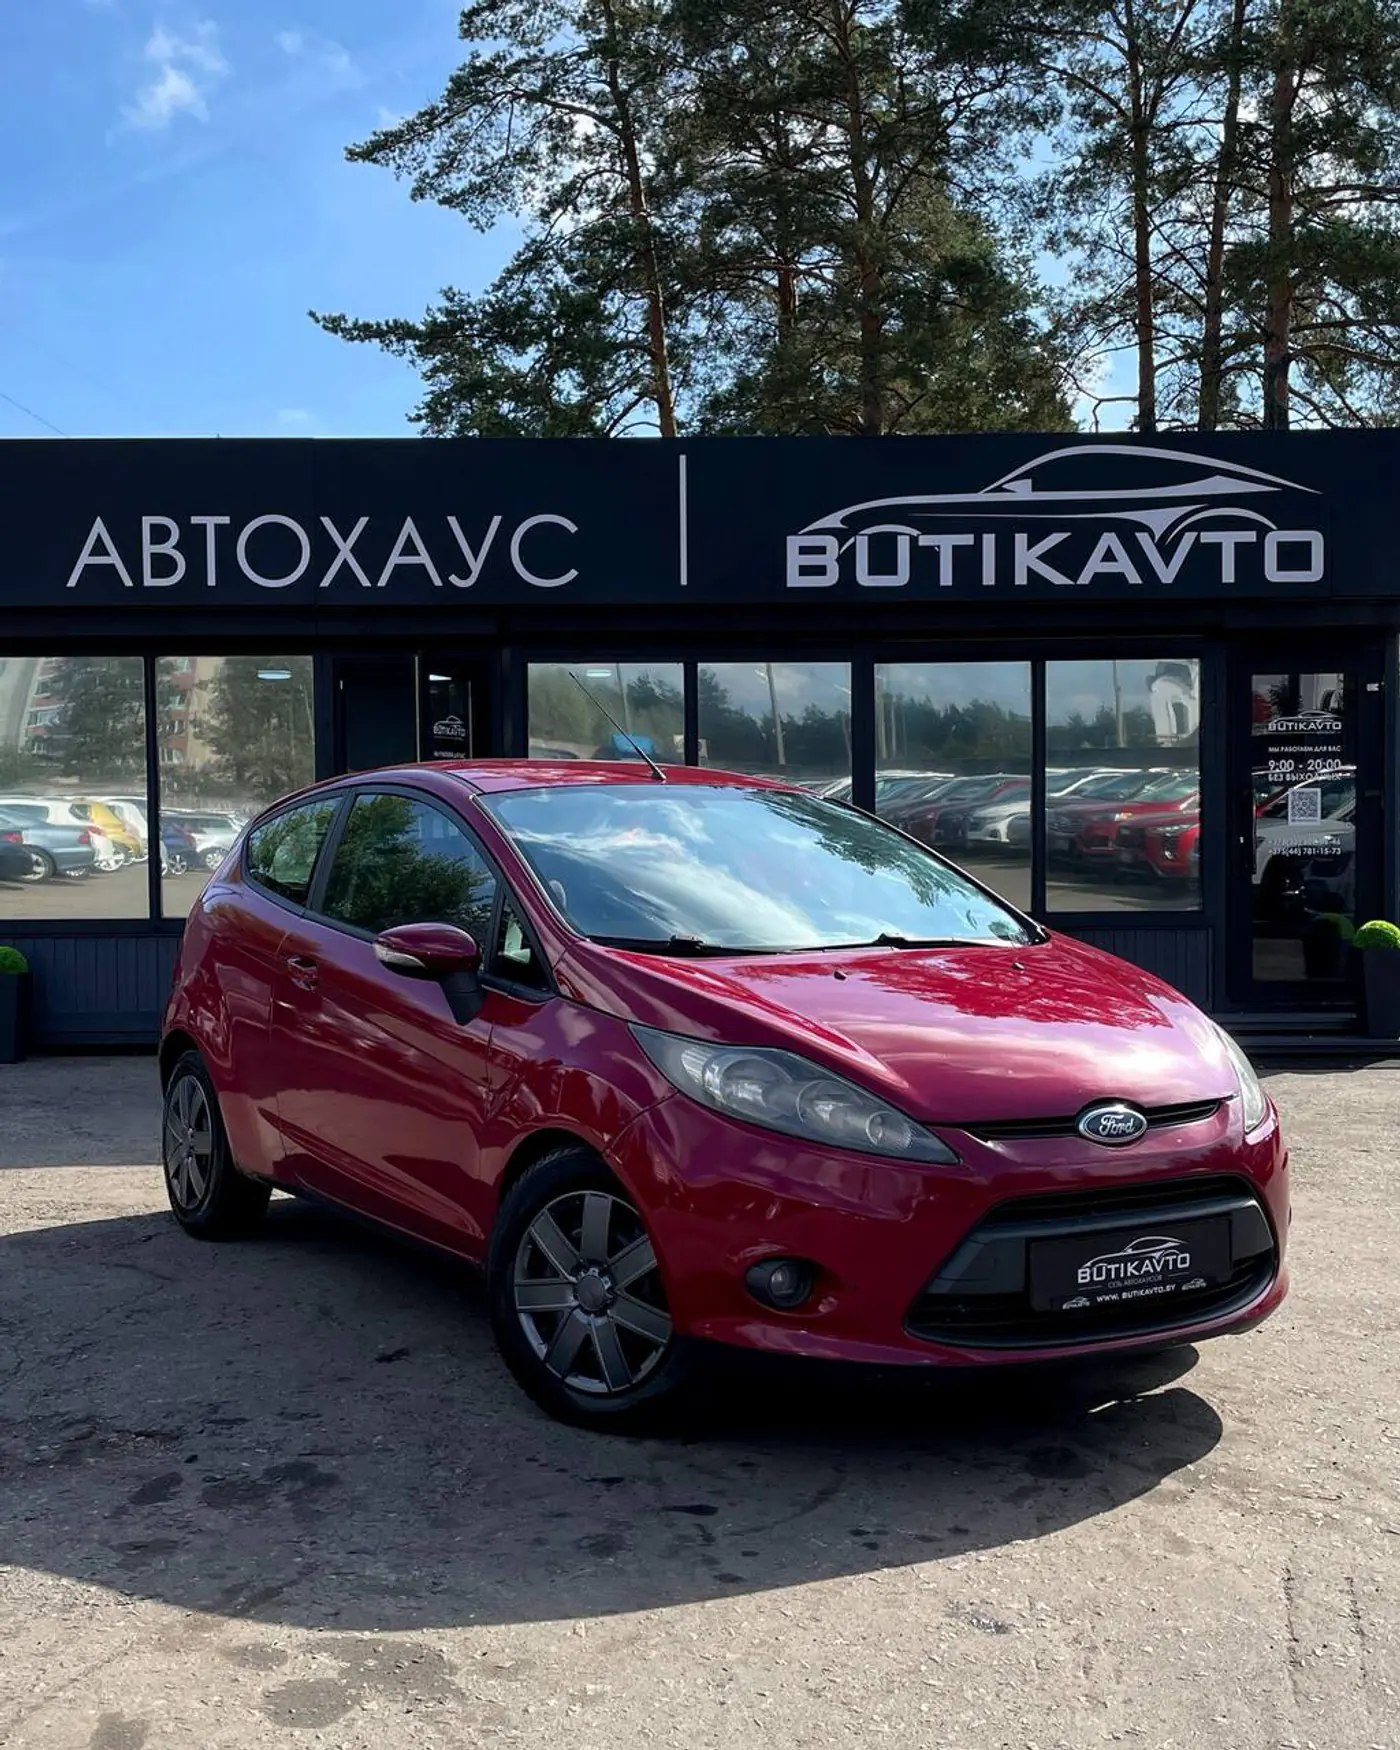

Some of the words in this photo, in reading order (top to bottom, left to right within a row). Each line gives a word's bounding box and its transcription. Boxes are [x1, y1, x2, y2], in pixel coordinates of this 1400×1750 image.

[66, 514, 579, 588] АВТОХАУС
[786, 530, 1325, 588] BUTIKAVTO
[1268, 720, 1342, 731] BUTIKAVTO
[1268, 759, 1295, 771] 9:00
[1307, 758, 1341, 771] 20:00
[1099, 1115, 1135, 1136] Ford
[1077, 1253, 1191, 1284] BUTIKAVTO
